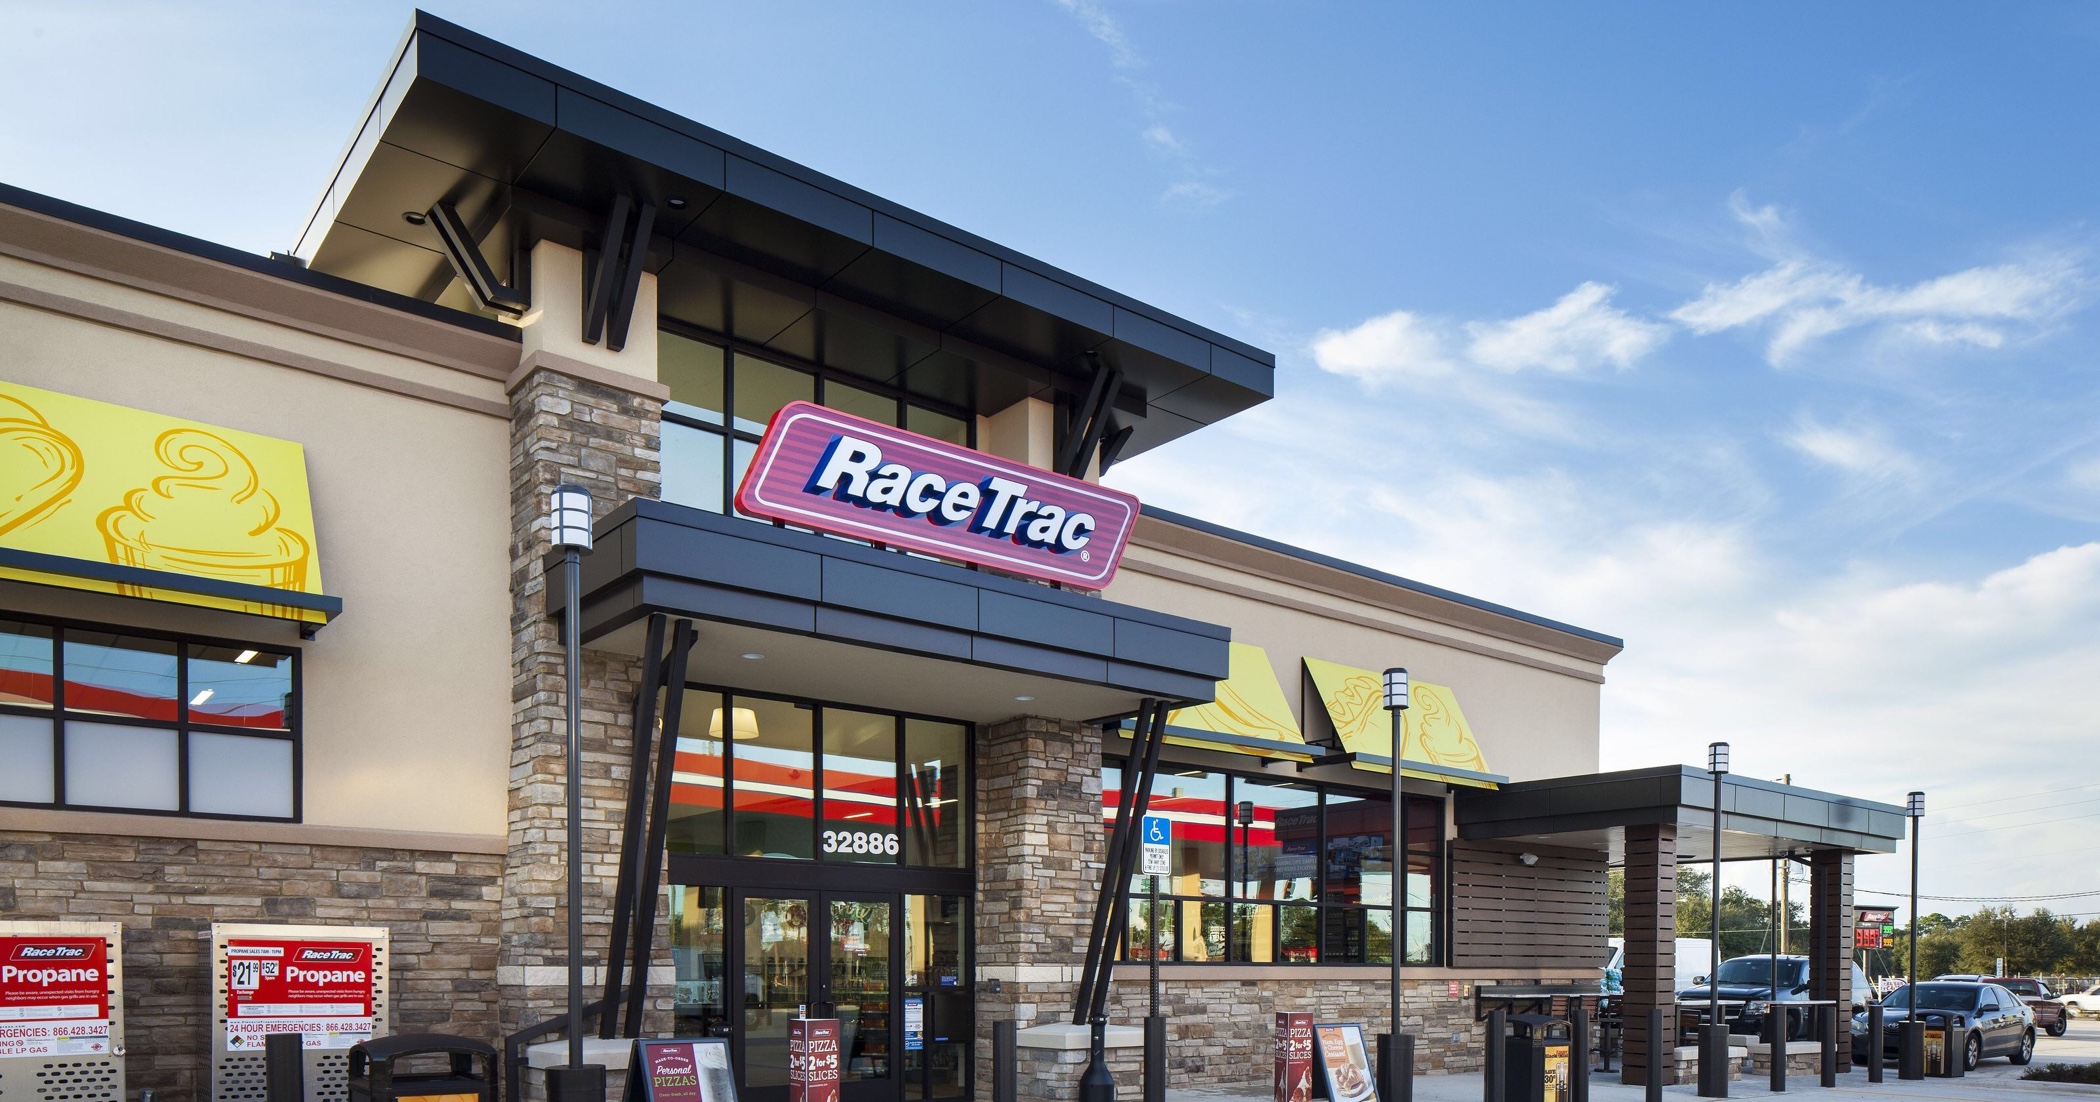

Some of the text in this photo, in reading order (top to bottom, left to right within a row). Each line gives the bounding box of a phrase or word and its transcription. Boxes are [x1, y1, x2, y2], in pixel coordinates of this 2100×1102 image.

[807, 434, 1096, 552] RaceTrac
[822, 830, 899, 855] 32886
[20, 946, 84, 957] RaceTrac
[301, 950, 354, 959] RaceTrac
[2, 965, 99, 987] Propane
[286, 966, 366, 986] Propane
[53, 1025, 108, 1036] 866.428.3427
[229, 1023, 371, 1033] 24 HOUR EMERGENCIES: 866.428.3427
[1289, 1028, 1312, 1038] PIZZA
[790, 1039, 806, 1053] PIZZA
[808, 1039, 838, 1053] PIZZA
[1289, 1040, 1296, 1051] 2
[1303, 1039, 1312, 1051] $5
[790, 1054, 795, 1069] 2
[799, 1055, 806, 1070] $5
[1289, 1051, 1312, 1060] SLICES
[808, 1054, 838, 1071] 2 for $5
[656, 1064, 692, 1075] Personal
[790, 1069, 806, 1081] SLICES
[808, 1069, 838, 1082] SLICES
[653, 1075, 697, 1088] PIZZAS
